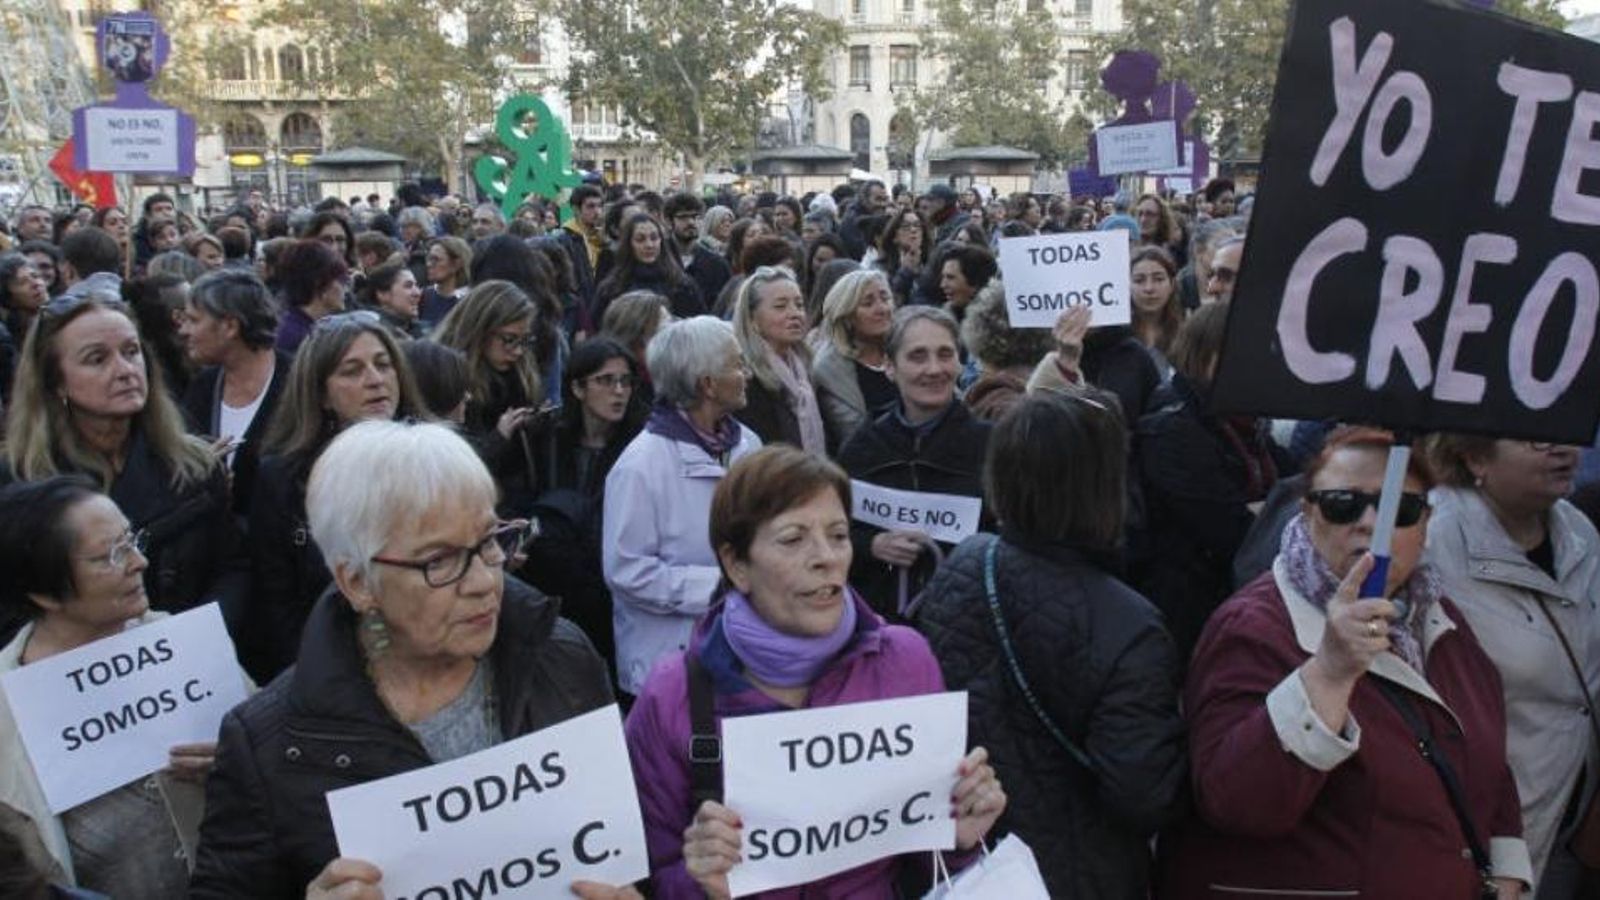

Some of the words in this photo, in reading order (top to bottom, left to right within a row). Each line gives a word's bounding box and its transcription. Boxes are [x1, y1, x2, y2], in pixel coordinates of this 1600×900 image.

[108, 118, 125, 129] NO
[1309, 16, 1433, 191] YO
[1494, 60, 1600, 226] TE
[1028, 242, 1101, 266] TODAS
[1016, 289, 1093, 311] SOMOS
[1097, 282, 1119, 306] C.
[1276, 217, 1600, 411] CREO
[862, 498, 891, 518] NO
[897, 506, 919, 524] ES
[924, 509, 961, 531] NO,
[65, 638, 174, 693] TODAS
[61, 689, 178, 752] SOMOS
[184, 679, 213, 703] C.
[780, 723, 915, 772] TODAS
[402, 751, 566, 832] TODAS
[747, 808, 890, 861] SOMOS
[900, 790, 934, 825] C.
[395, 847, 561, 900] OMOS
[572, 821, 621, 865] C.
